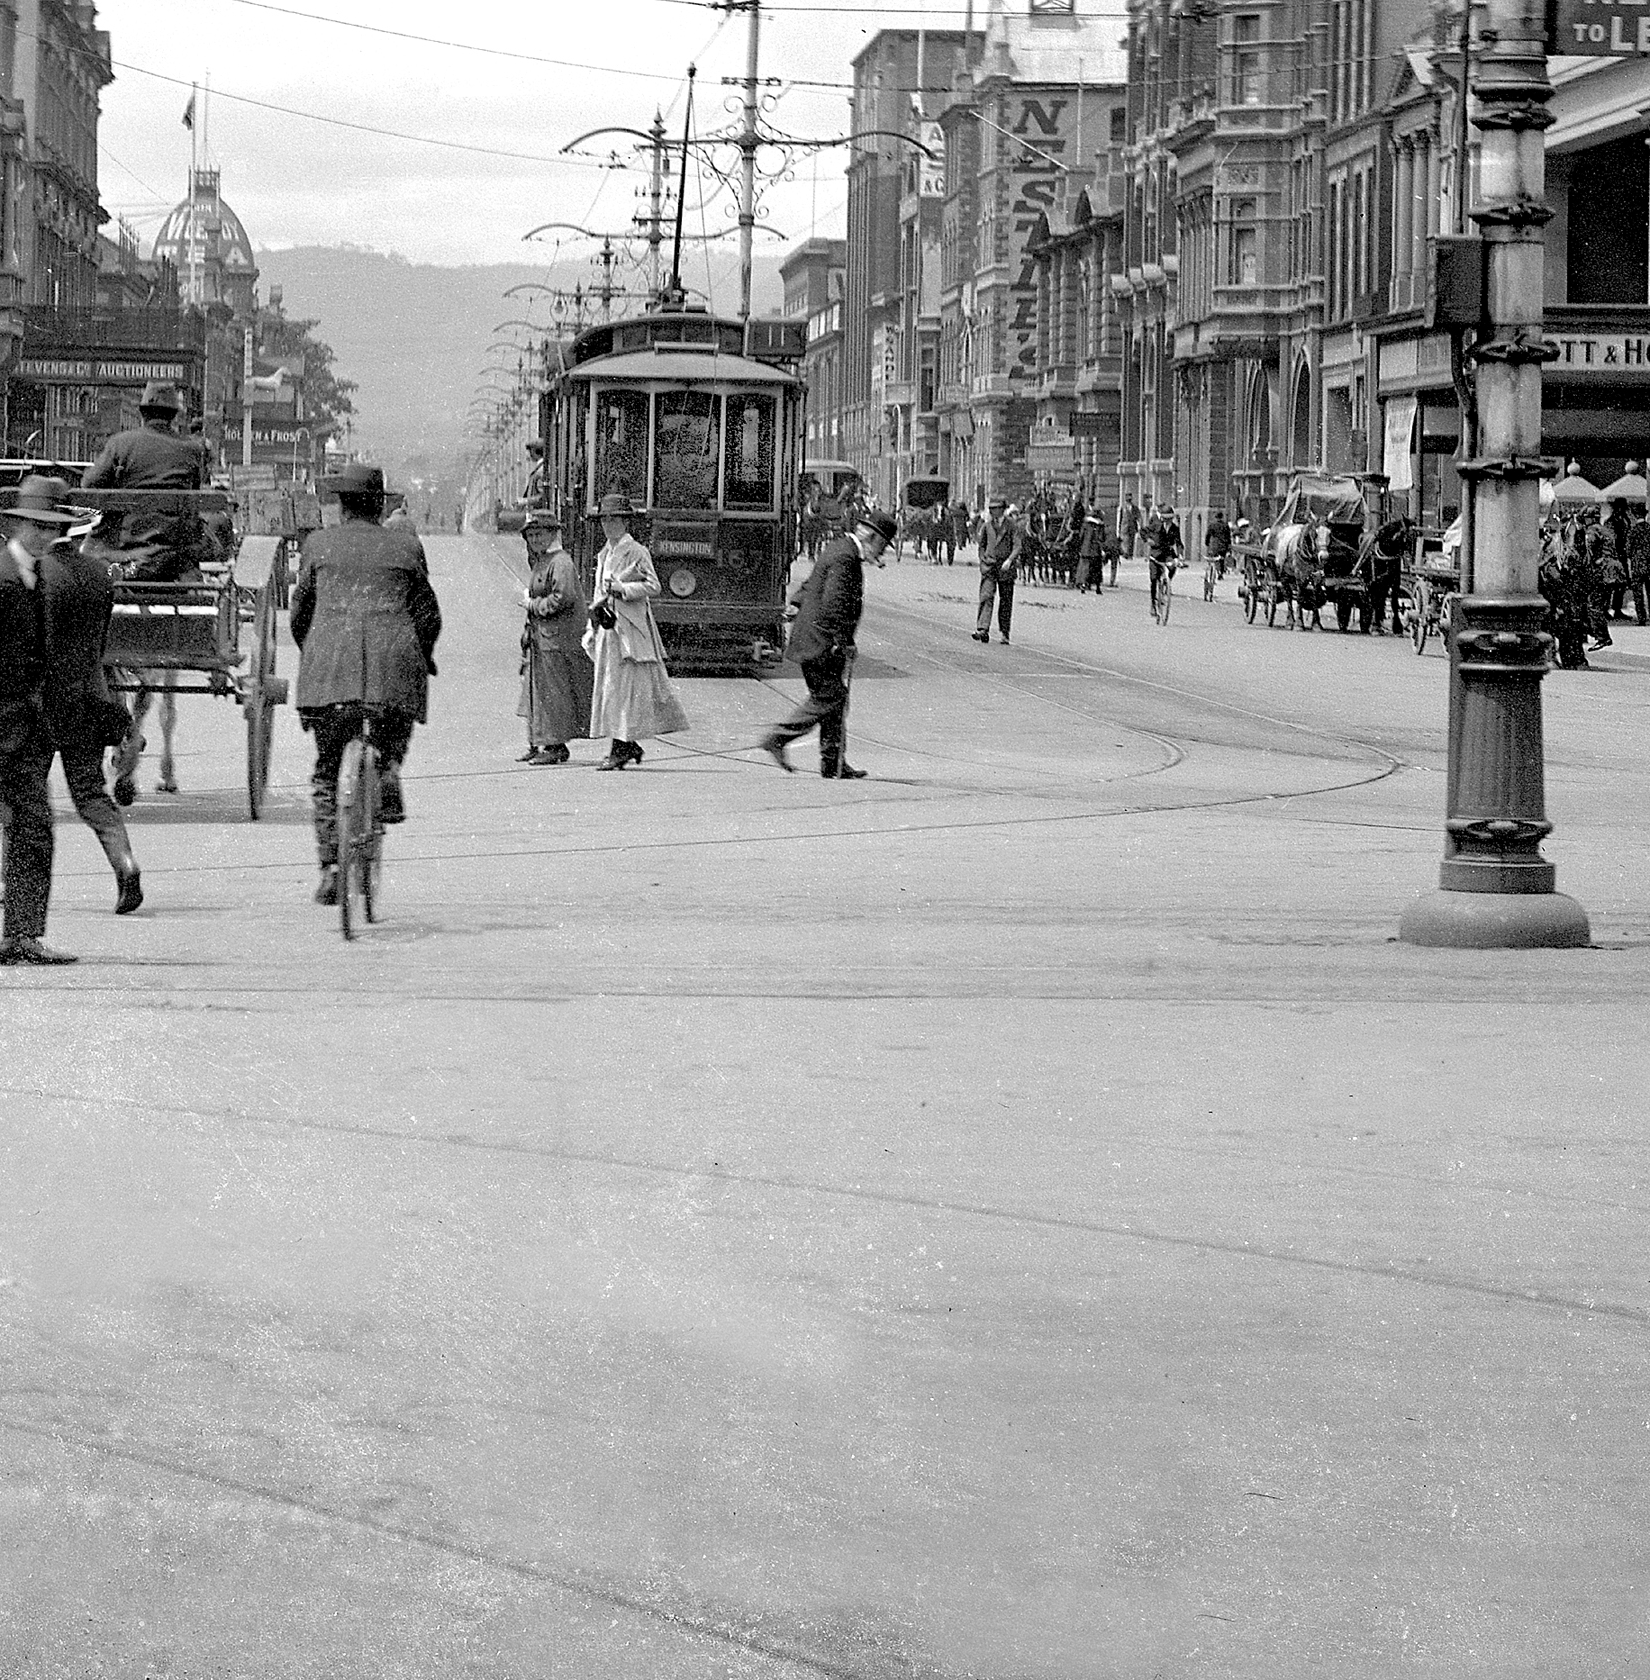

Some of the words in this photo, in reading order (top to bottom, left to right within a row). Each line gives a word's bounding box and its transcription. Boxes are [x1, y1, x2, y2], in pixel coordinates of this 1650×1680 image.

[1573, 23, 1604, 42] TO
[1604, 344, 1620, 364] &
[97, 362, 185, 379] AUCTIONEERS
[660, 541, 711, 556] KENSINGTON
